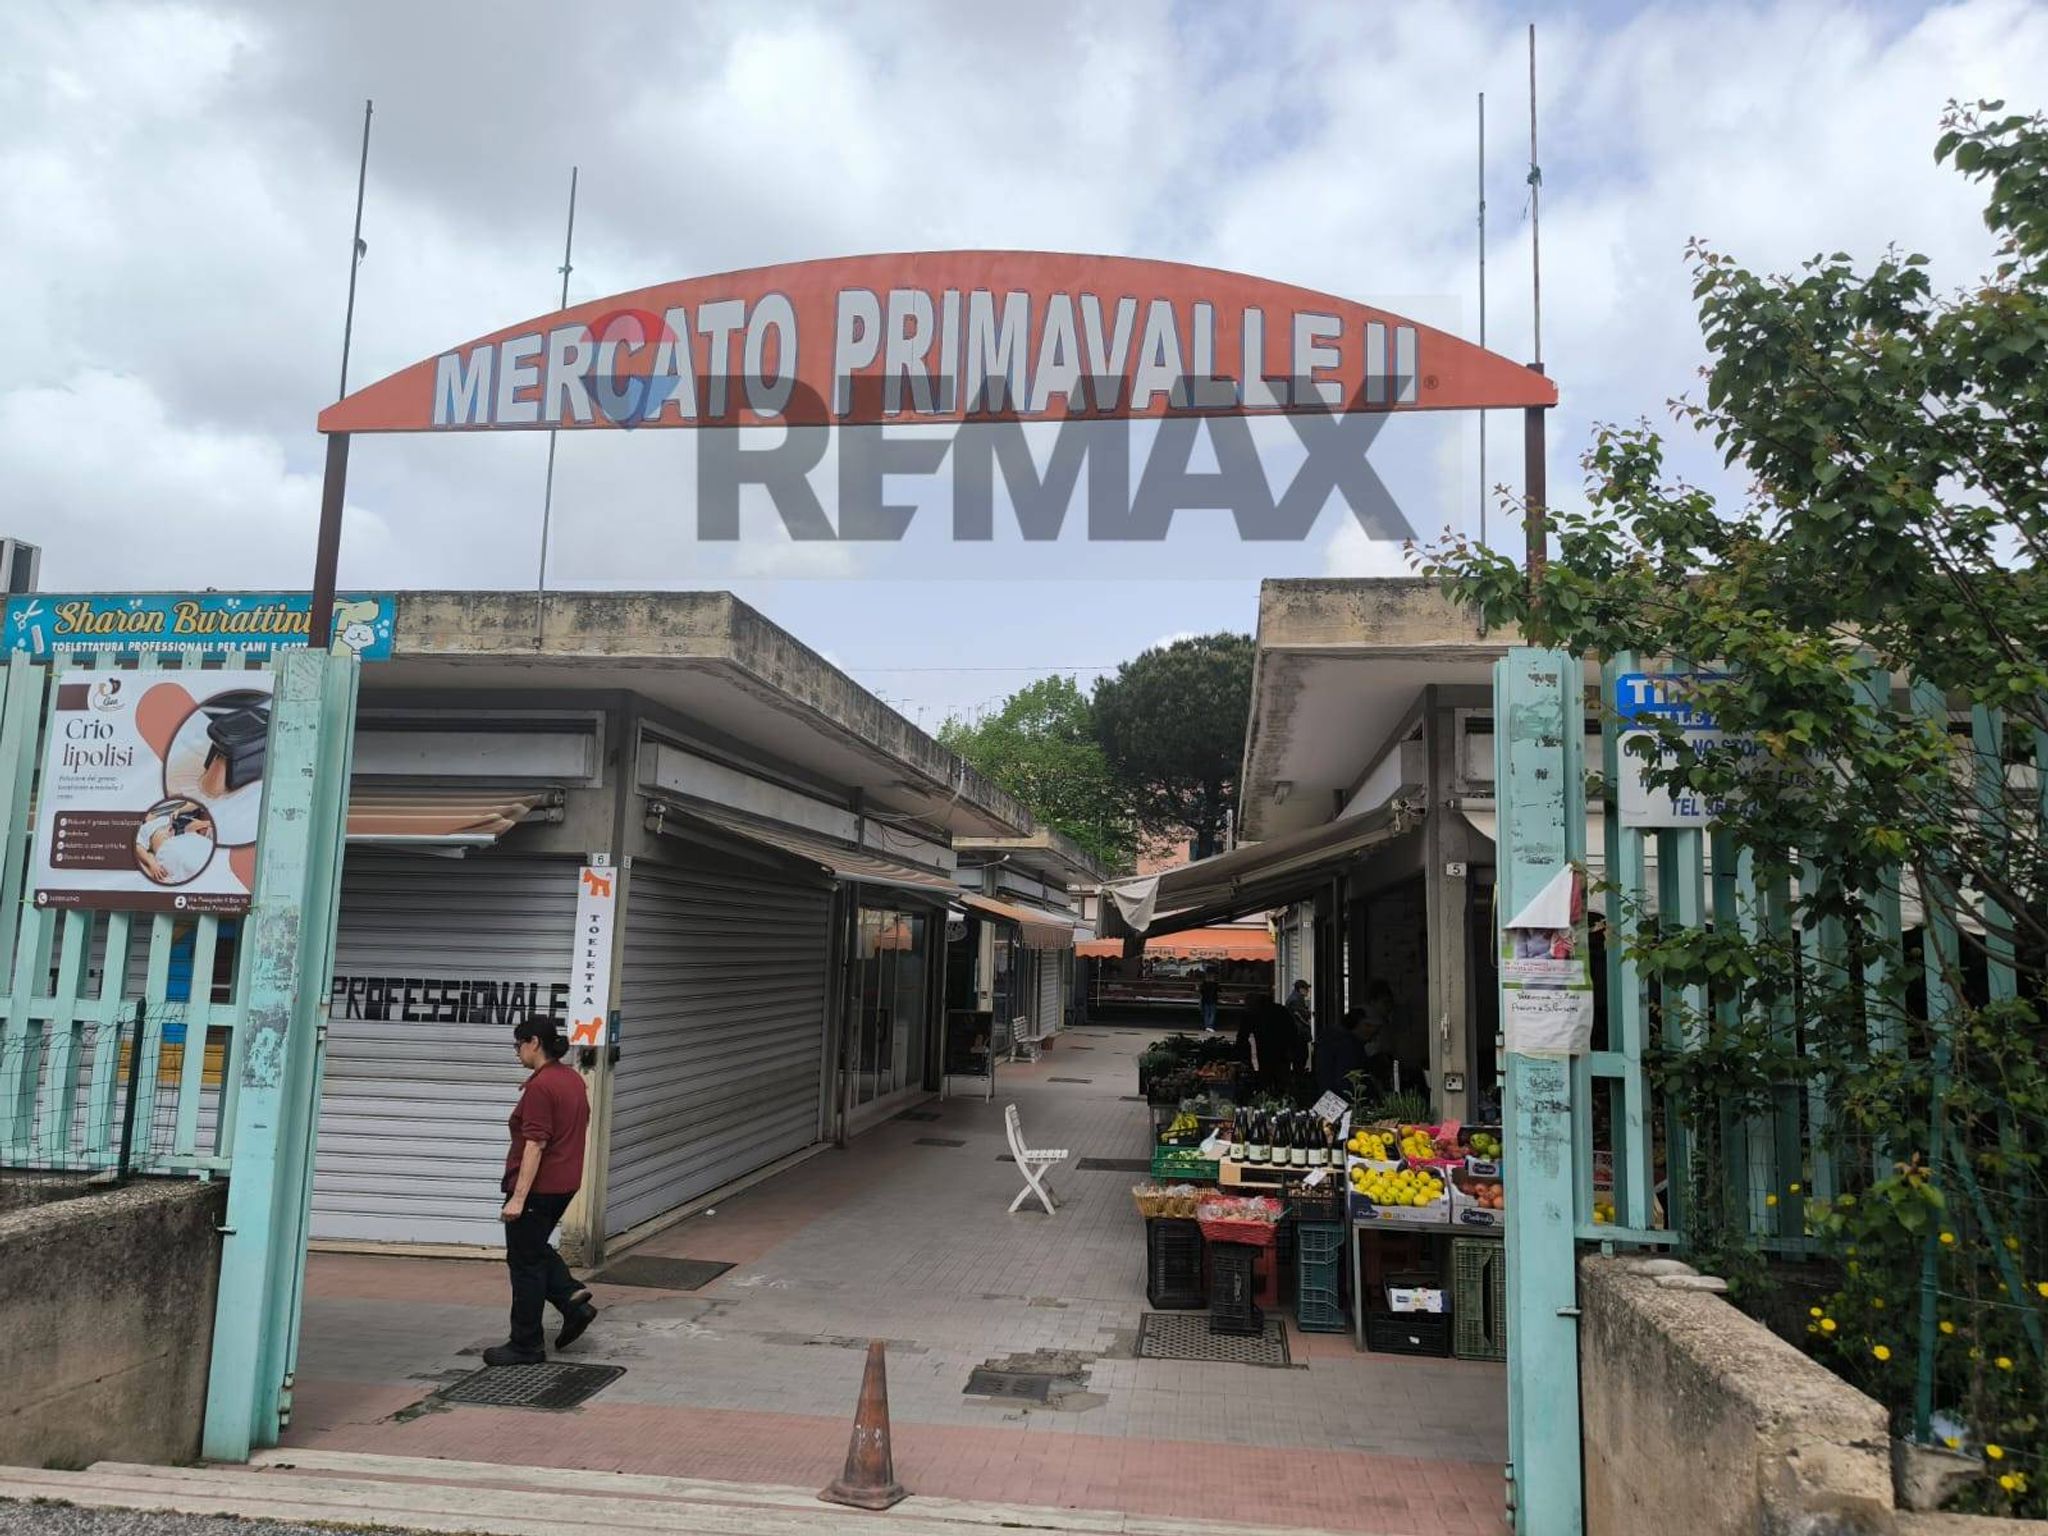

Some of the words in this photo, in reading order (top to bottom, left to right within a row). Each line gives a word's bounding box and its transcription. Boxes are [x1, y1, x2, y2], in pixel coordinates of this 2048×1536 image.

[433, 291, 798, 426] MERCATO
[834, 286, 1344, 416] PRIMAVALLE
[1364, 321, 1419, 405] II
[53, 600, 165, 635] Sharon
[172, 600, 312, 635] Burattini
[52, 641, 125, 653] TOELETTATURA
[127, 641, 214, 653] PROFESSIONALE
[217, 641, 237, 653] PER
[241, 641, 267, 653] CANI
[66, 717, 114, 740] Crio
[62, 742, 133, 773] lipolisi
[1671, 798, 1700, 817] TEL
[597, 855, 604, 865] 6
[1453, 864, 1461, 875] 5
[582, 914, 601, 1005] TOELETTA
[330, 976, 570, 1028] PROFESSIONALE
